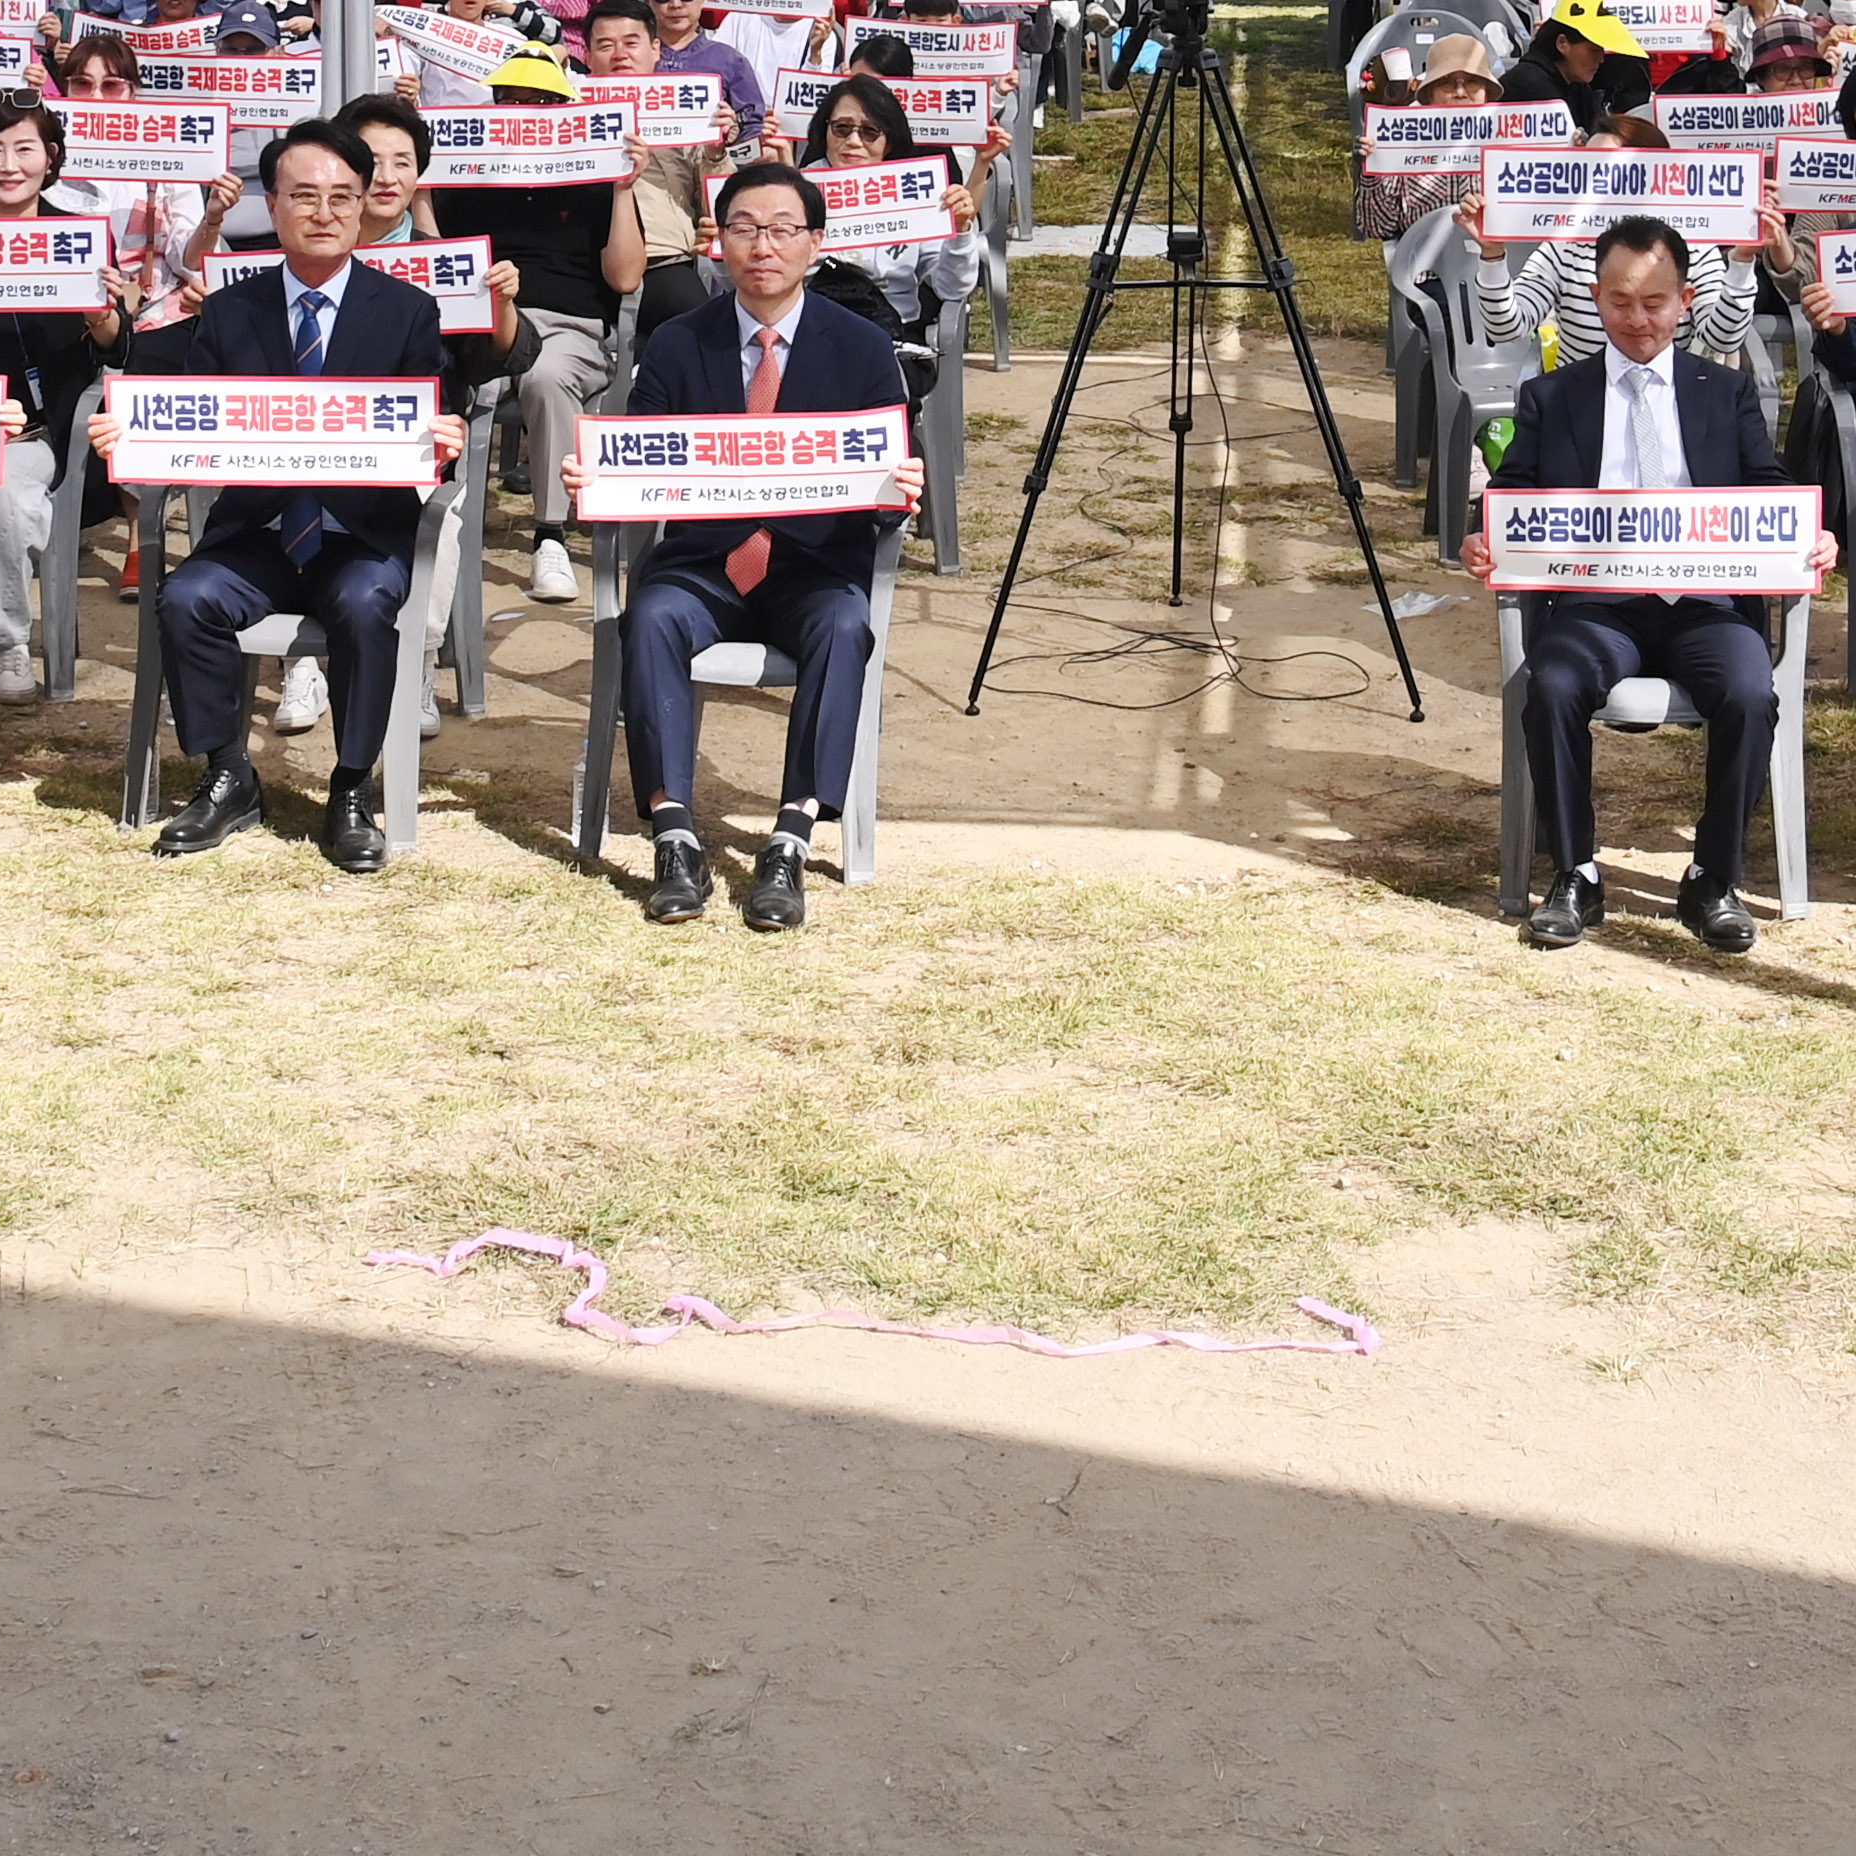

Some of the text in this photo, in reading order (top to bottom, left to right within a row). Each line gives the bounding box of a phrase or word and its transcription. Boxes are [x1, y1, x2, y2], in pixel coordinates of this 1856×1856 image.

[1498, 162, 1744, 196] 소상공인이 살아야 사천이 산다
[130, 394, 417, 432] 사천공항 국제공항 승격 촉구
[171, 455, 377, 469] KFME 사천시소상공인연합회
[599, 427, 887, 466] 사천공항 국제공항 승격 촉구
[642, 485, 848, 501] KFME 사천시소상공인연합회
[1506, 506, 1797, 542] 소상공인이 살아야 사천이 산다
[1548, 563, 1756, 577] KFME 사천시소상공인연합회
